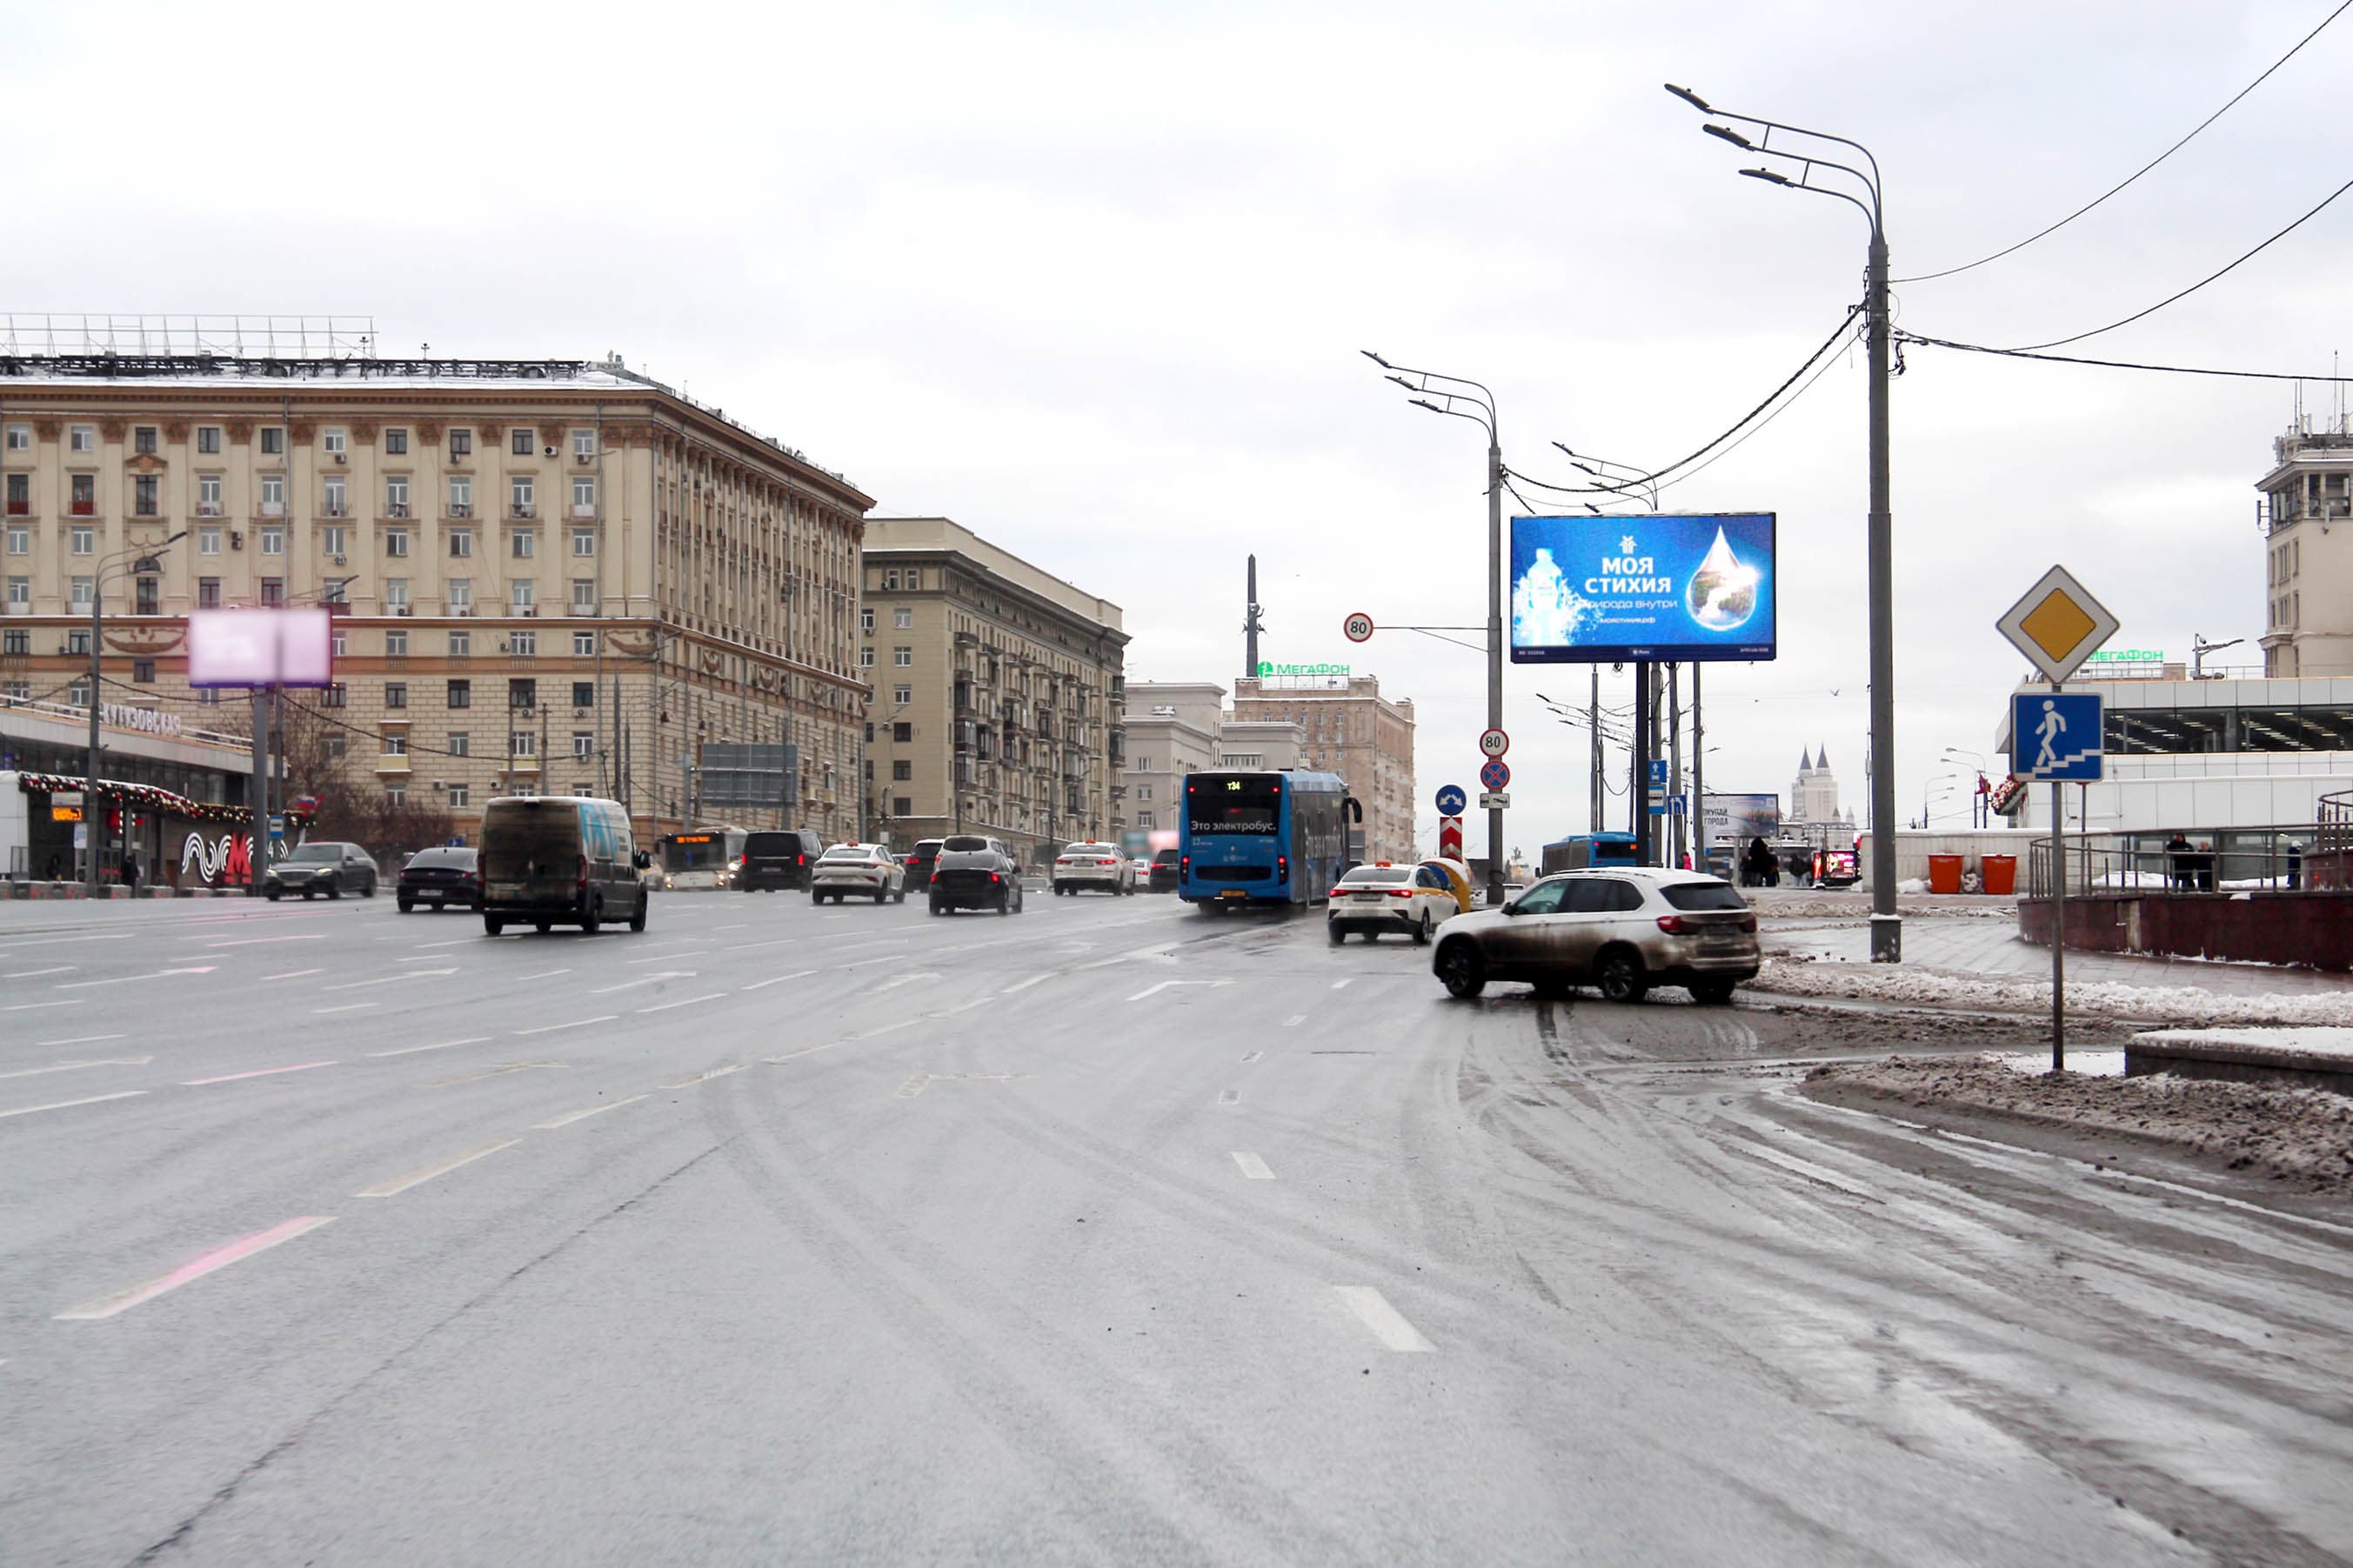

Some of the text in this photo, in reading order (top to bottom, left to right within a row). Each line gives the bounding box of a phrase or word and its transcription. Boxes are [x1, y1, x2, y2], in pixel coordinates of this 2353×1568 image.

[1602, 557, 1654, 575] МОЯ
[1585, 577, 1671, 593] СТИХИЯ
[1635, 599, 1678, 609] внутри
[1350, 621, 1367, 634] 80
[1486, 736, 1501, 748] 80
[1191, 821, 1277, 832] Это электробус.
